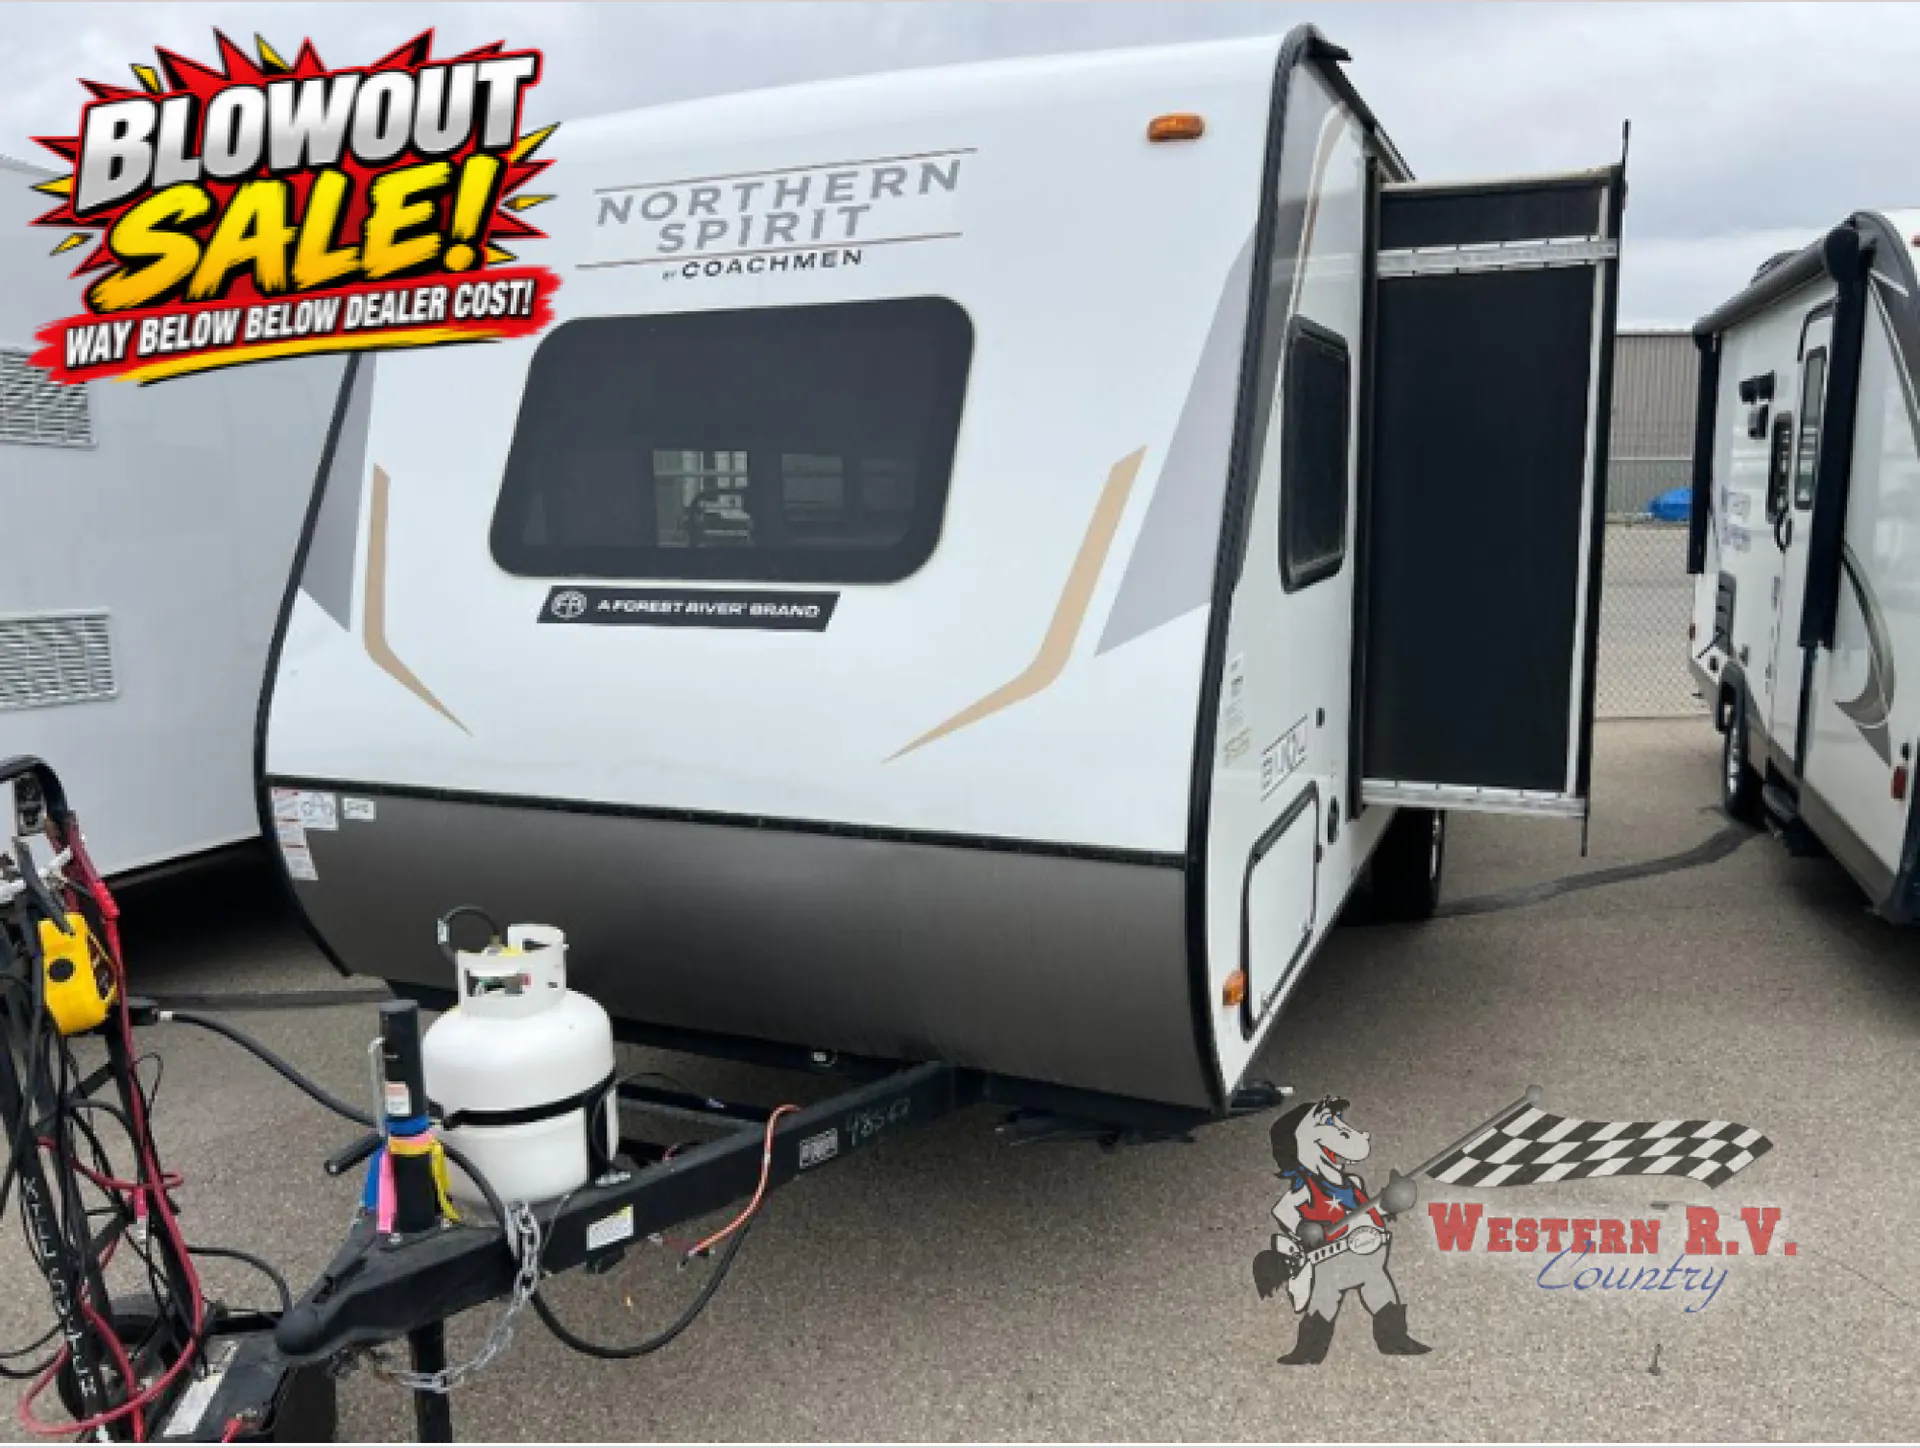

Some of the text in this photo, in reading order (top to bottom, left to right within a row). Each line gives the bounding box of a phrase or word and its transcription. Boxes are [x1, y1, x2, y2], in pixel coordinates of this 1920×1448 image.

[597, 158, 961, 226] NORTHERN
[657, 204, 871, 254] SPIRIT
[681, 249, 863, 280] COACHMEN
[597, 599, 610, 613] A
[613, 599, 682, 614] FOREST
[749, 602, 820, 618] BRAND
